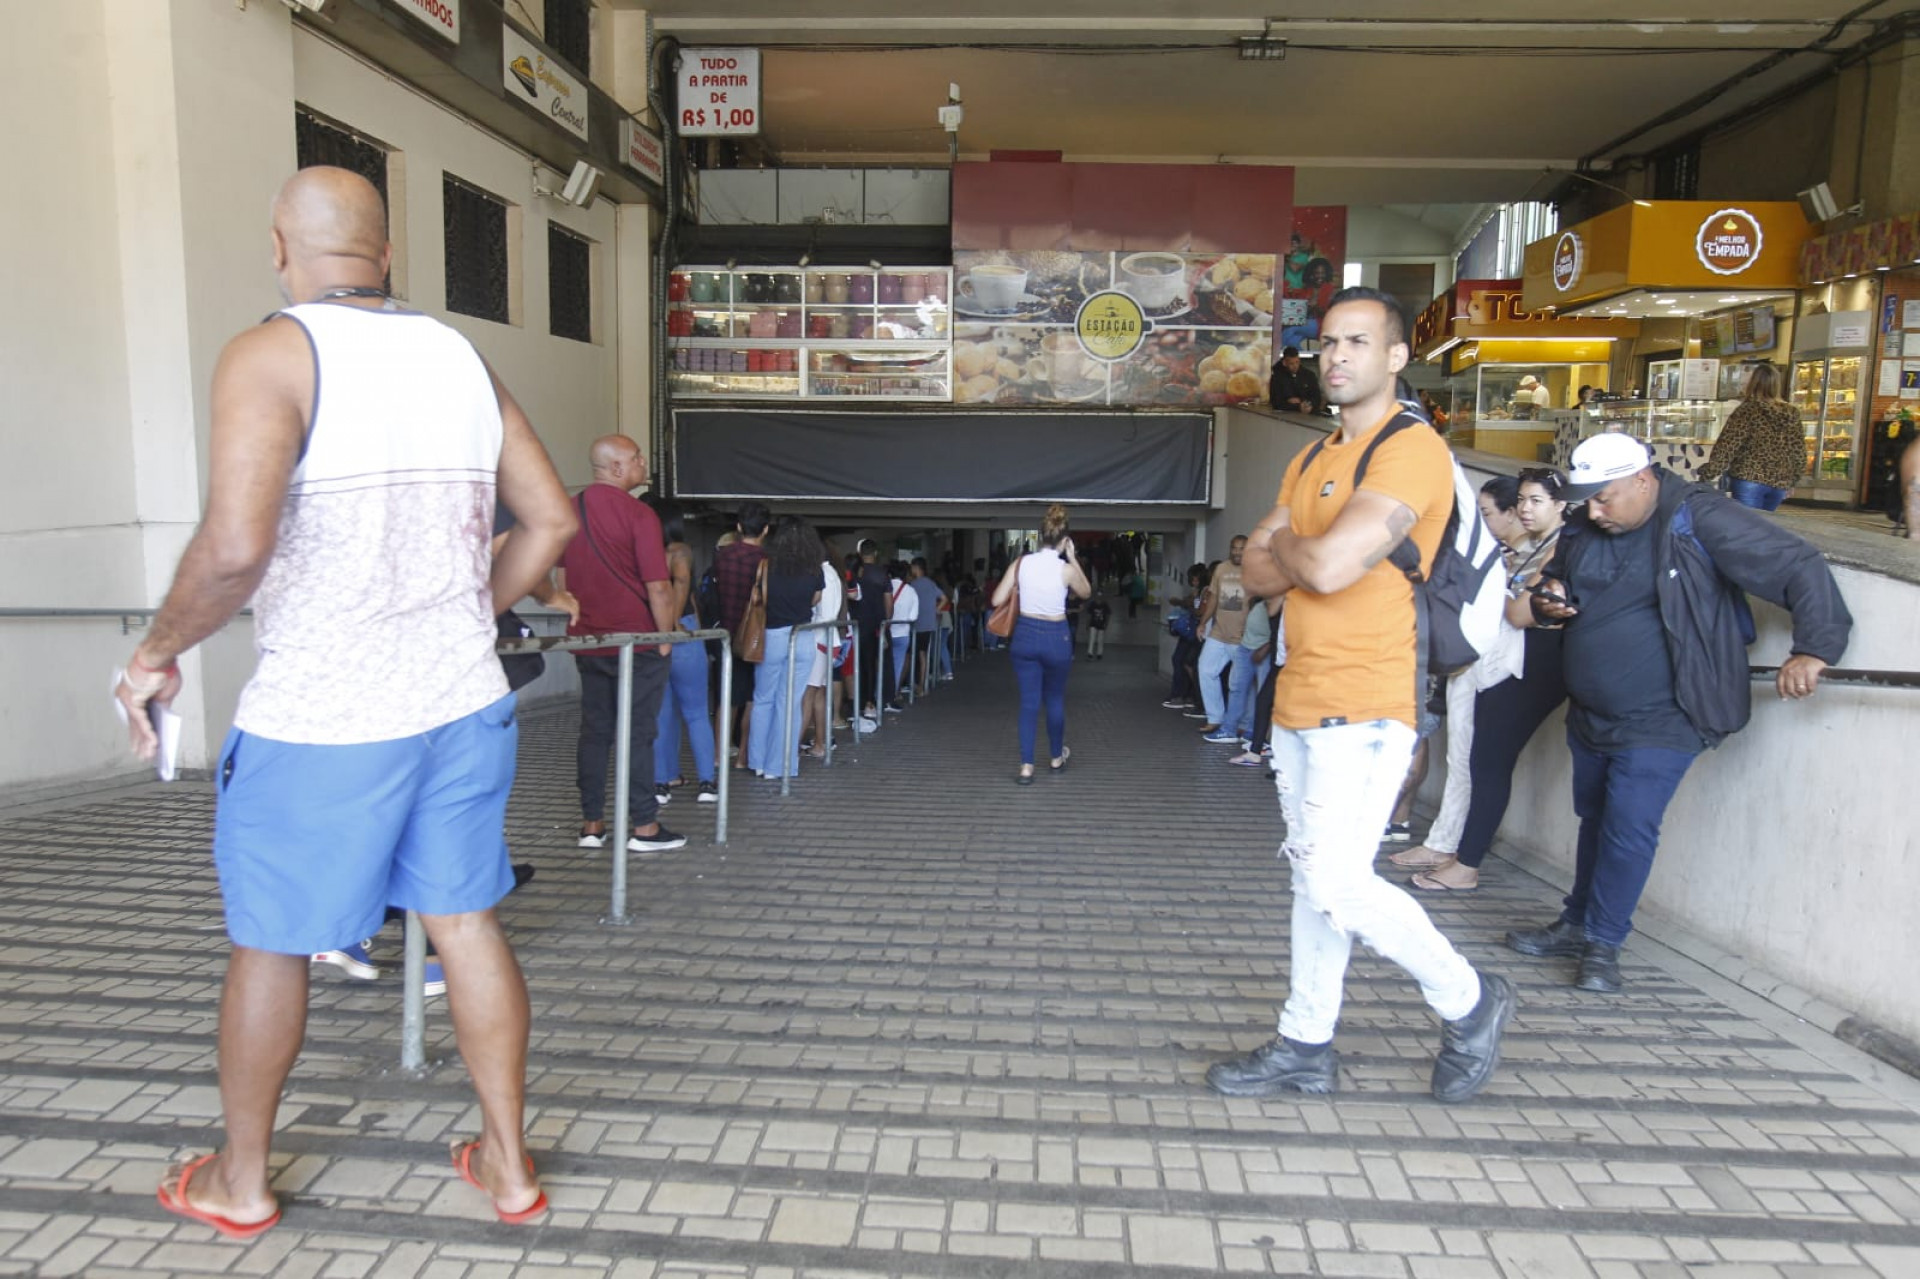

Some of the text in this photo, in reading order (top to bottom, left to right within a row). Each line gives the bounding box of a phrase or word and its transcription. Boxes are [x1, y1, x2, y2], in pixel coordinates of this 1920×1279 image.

[700, 57, 737, 70] TUDO
[689, 74, 748, 87] A PARTIR
[710, 91, 727, 104] DE
[551, 96, 585, 132] Central
[682, 107, 755, 129] R$ 1,00
[1704, 242, 1750, 257] EMPADA
